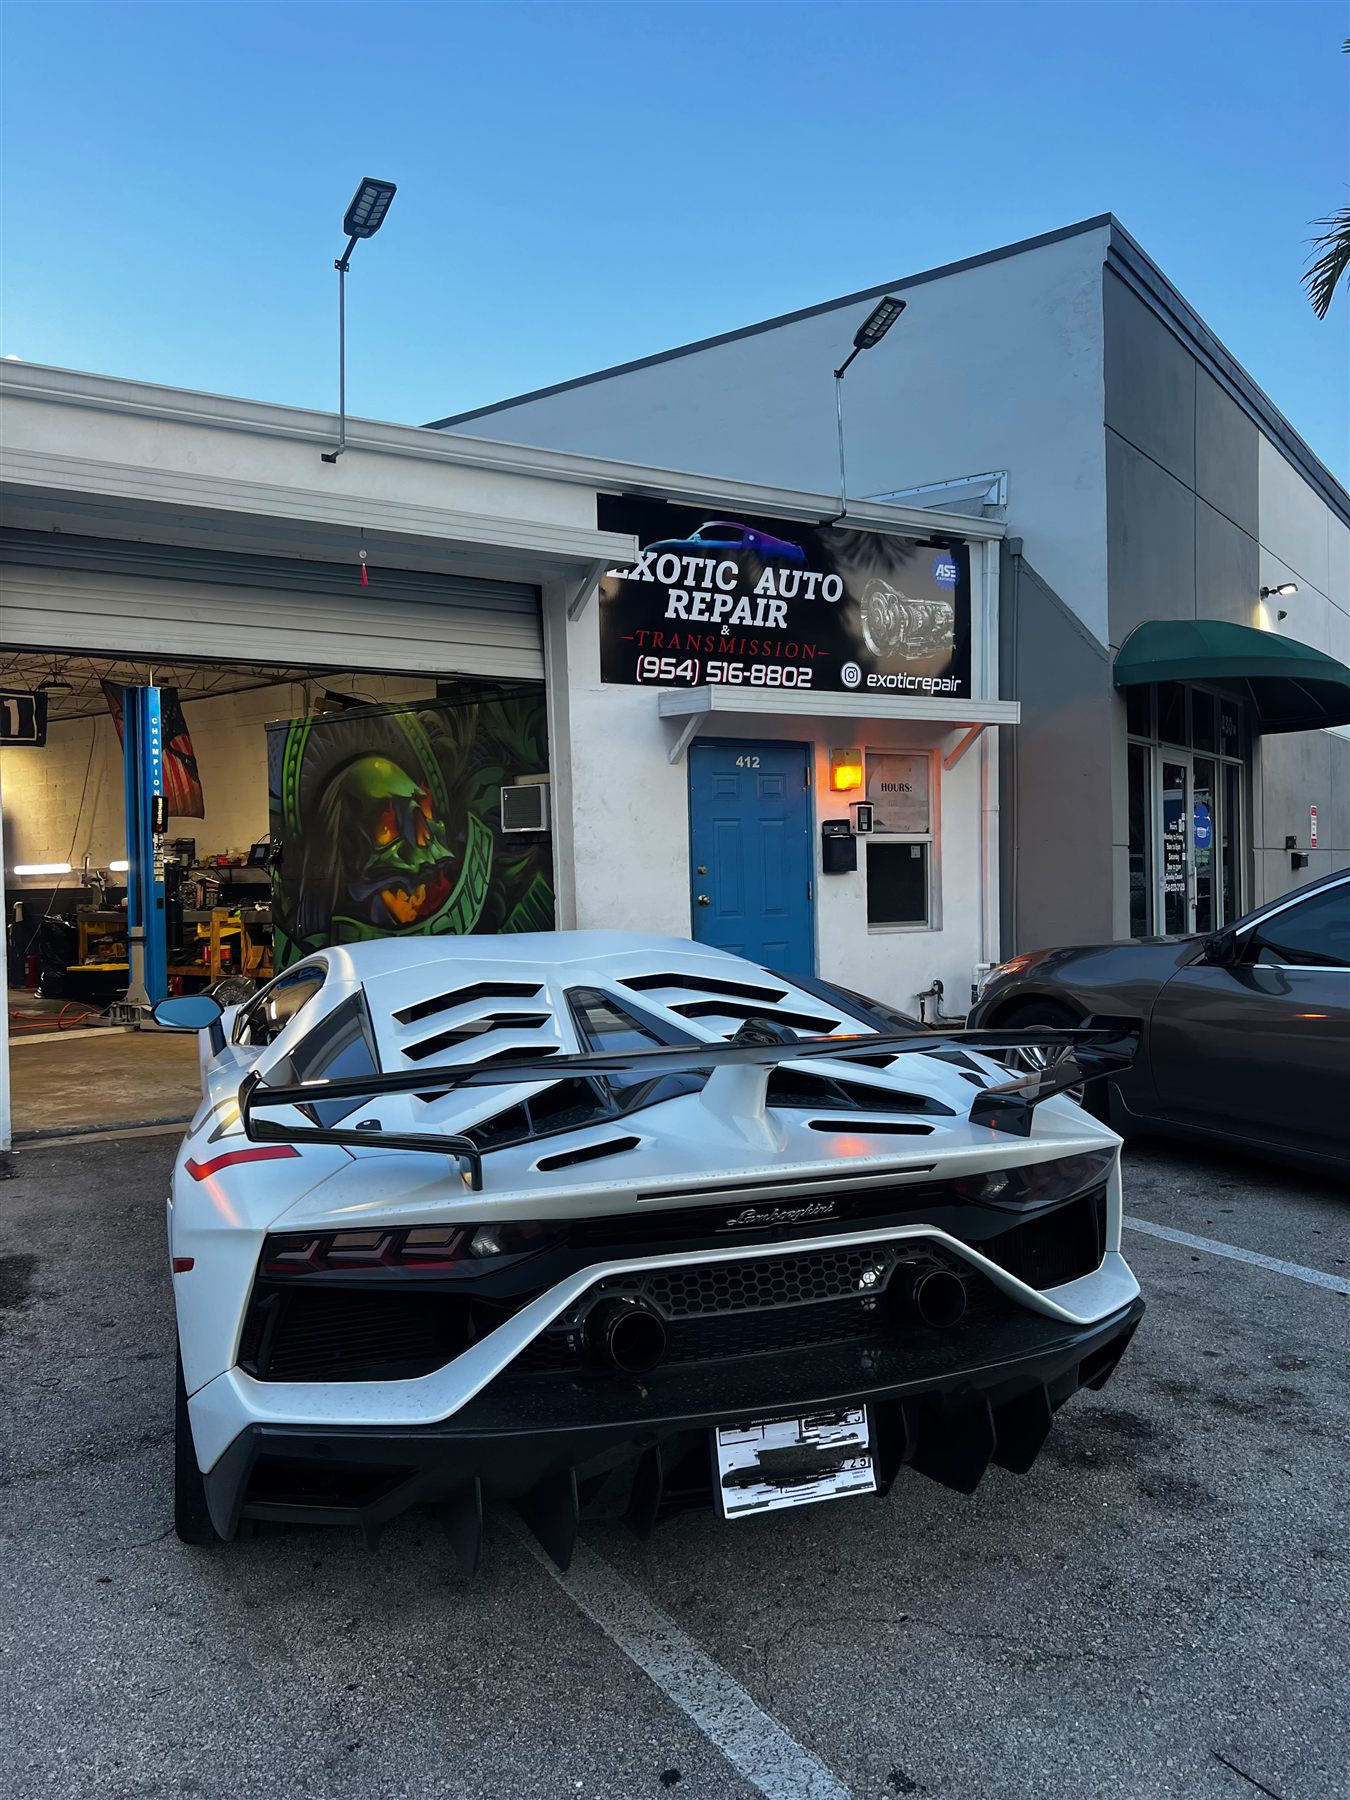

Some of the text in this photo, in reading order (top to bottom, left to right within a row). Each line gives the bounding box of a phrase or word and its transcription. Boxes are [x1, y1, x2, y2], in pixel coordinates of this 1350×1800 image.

[936, 564, 956, 577] ASE
[753, 567, 844, 602] AUTO
[664, 589, 788, 628] REPAIR
[720, 625, 730, 635] &
[636, 630, 817, 660] TRANSMISSION
[636, 655, 813, 688] (954) 516-8802
[866, 672, 962, 695] exoticrepair
[151, 717, 160, 796] CHAMPION
[735, 755, 760, 768] 412
[881, 782, 913, 793] HOURS:
[726, 1201, 835, 1226] Lamborghini
